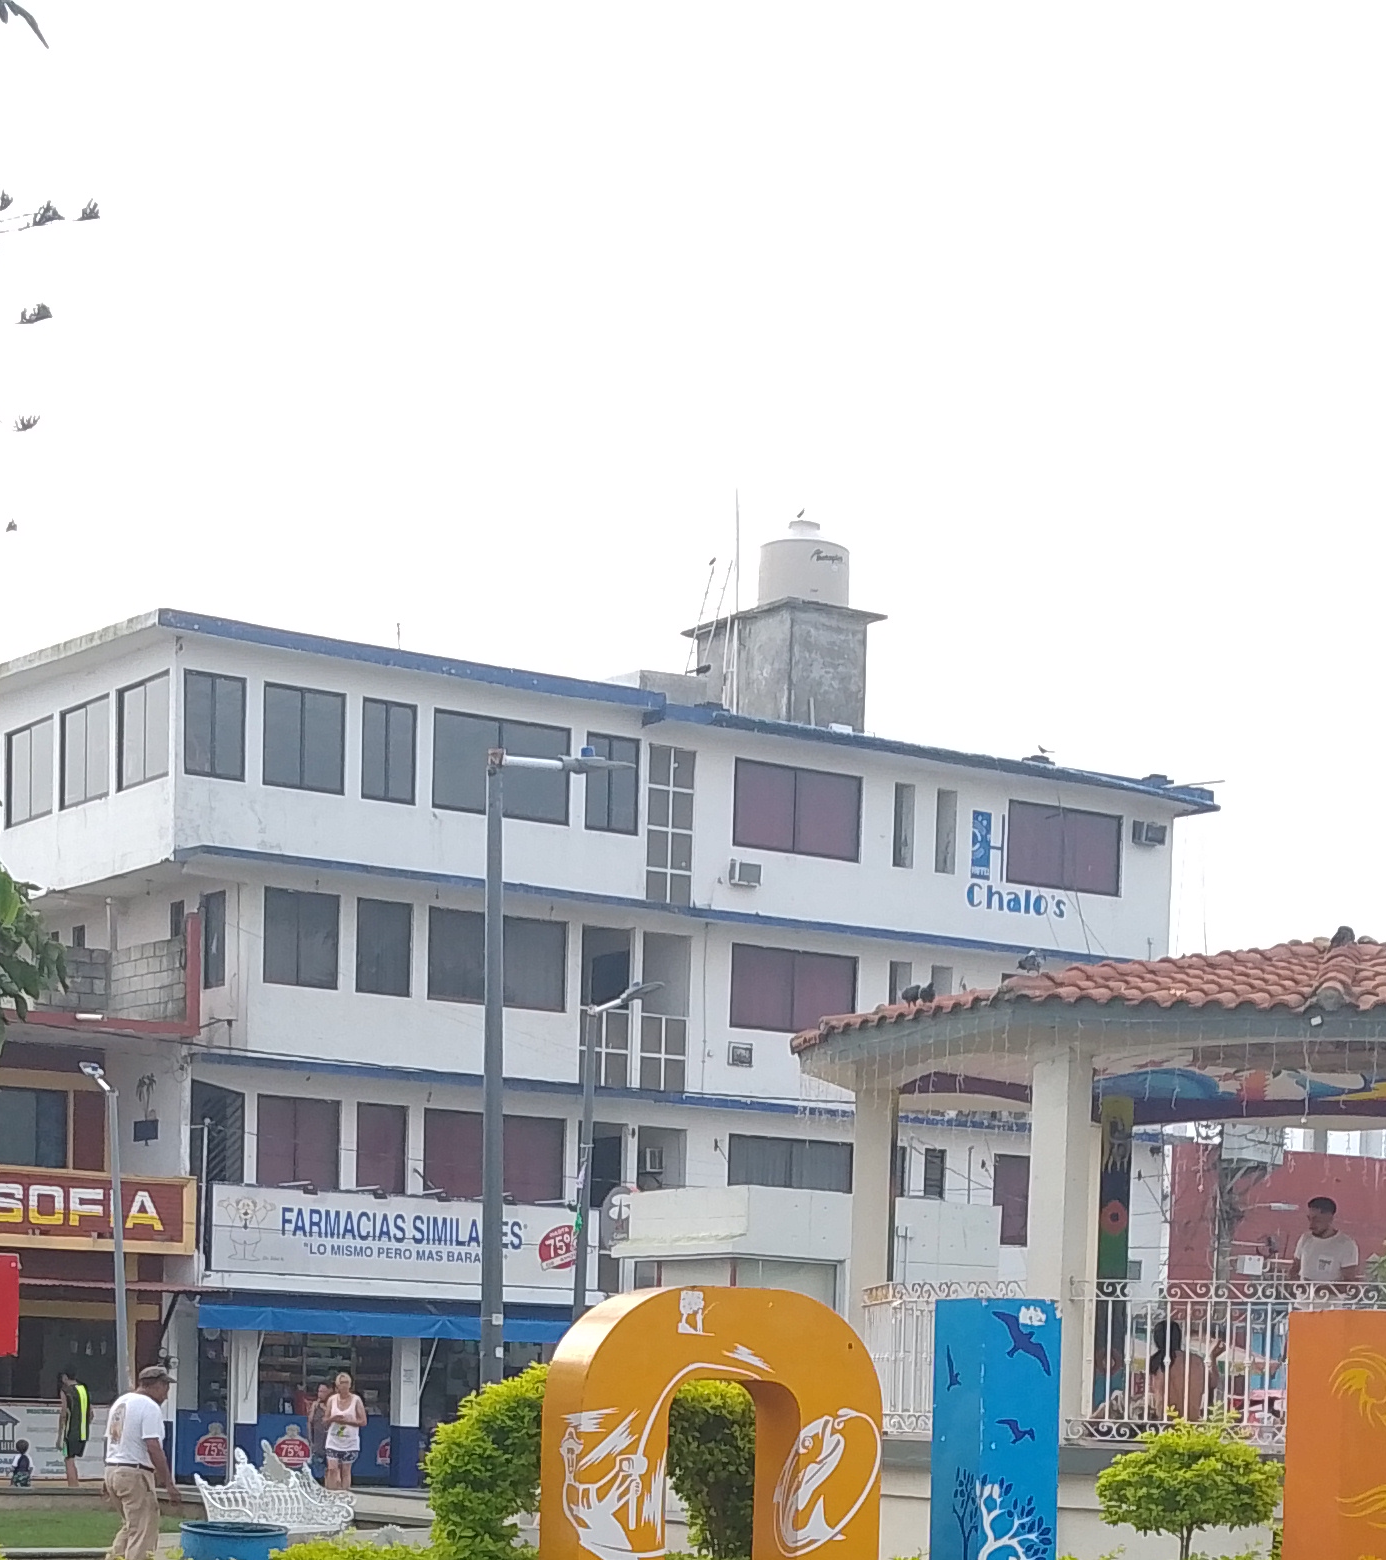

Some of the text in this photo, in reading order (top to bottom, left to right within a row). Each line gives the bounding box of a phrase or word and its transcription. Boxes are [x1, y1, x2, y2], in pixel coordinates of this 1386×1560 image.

[966, 882, 1066, 919] Chalo's
[281, 1206, 523, 1251] FARMACIAS SIMILAES
[330, 1244, 374, 1259] MISMO
[376, 1247, 413, 1261] PERO
[415, 1249, 444, 1263] MAS
[446, 1251, 483, 1265] BARA
